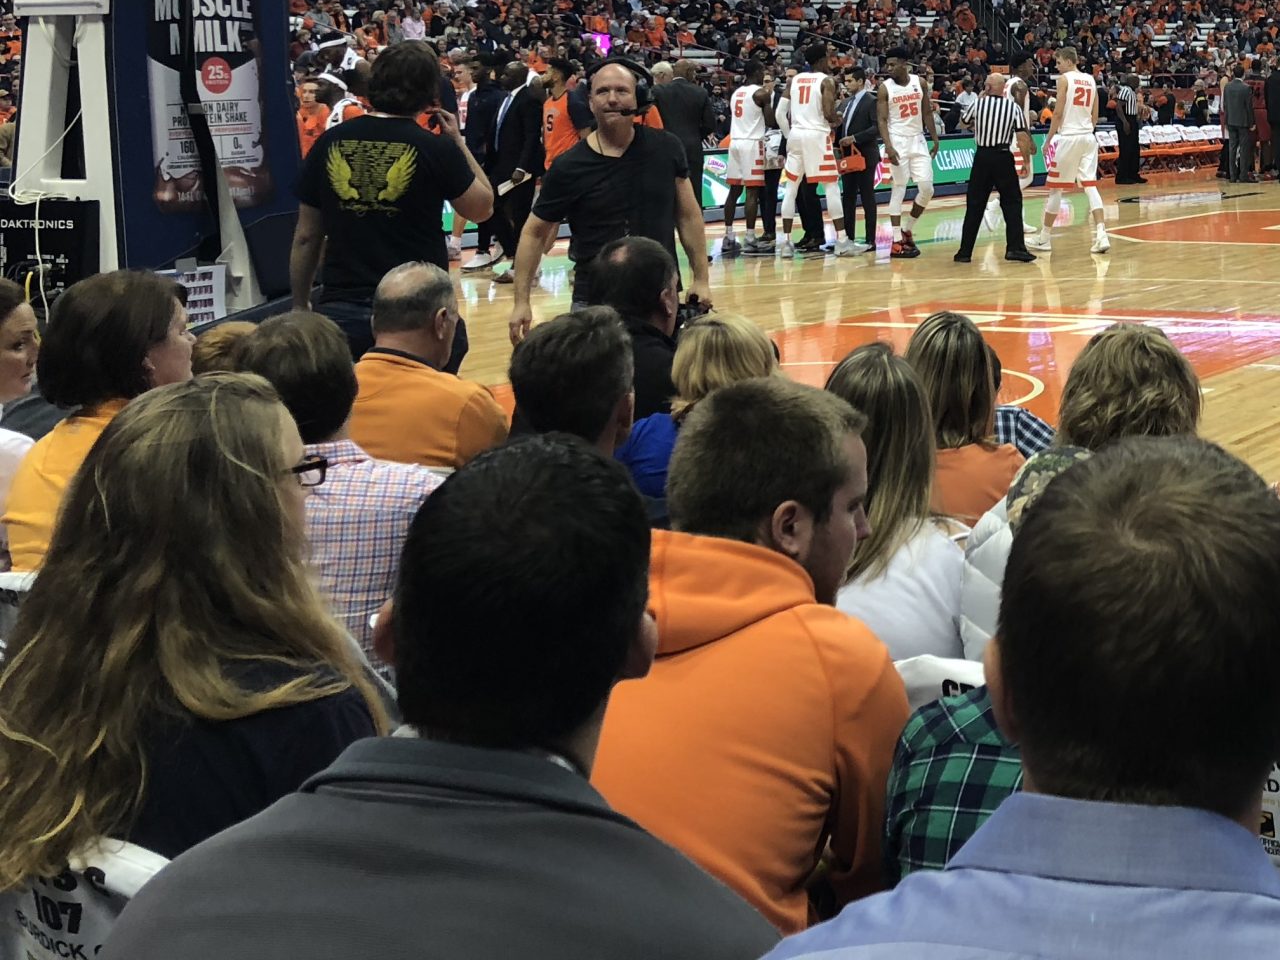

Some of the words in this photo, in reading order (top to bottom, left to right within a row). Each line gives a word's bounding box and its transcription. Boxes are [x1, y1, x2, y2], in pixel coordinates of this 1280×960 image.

[798, 86, 811, 104] 11
[892, 93, 921, 104] ORANGE
[1073, 87, 1092, 107] 21
[216, 101, 240, 113] DAIRY
[899, 102, 919, 118] 25
[225, 111, 248, 122] SHAKE
[1, 219, 74, 229] DAKTRONICS
[33, 887, 83, 934] 107
